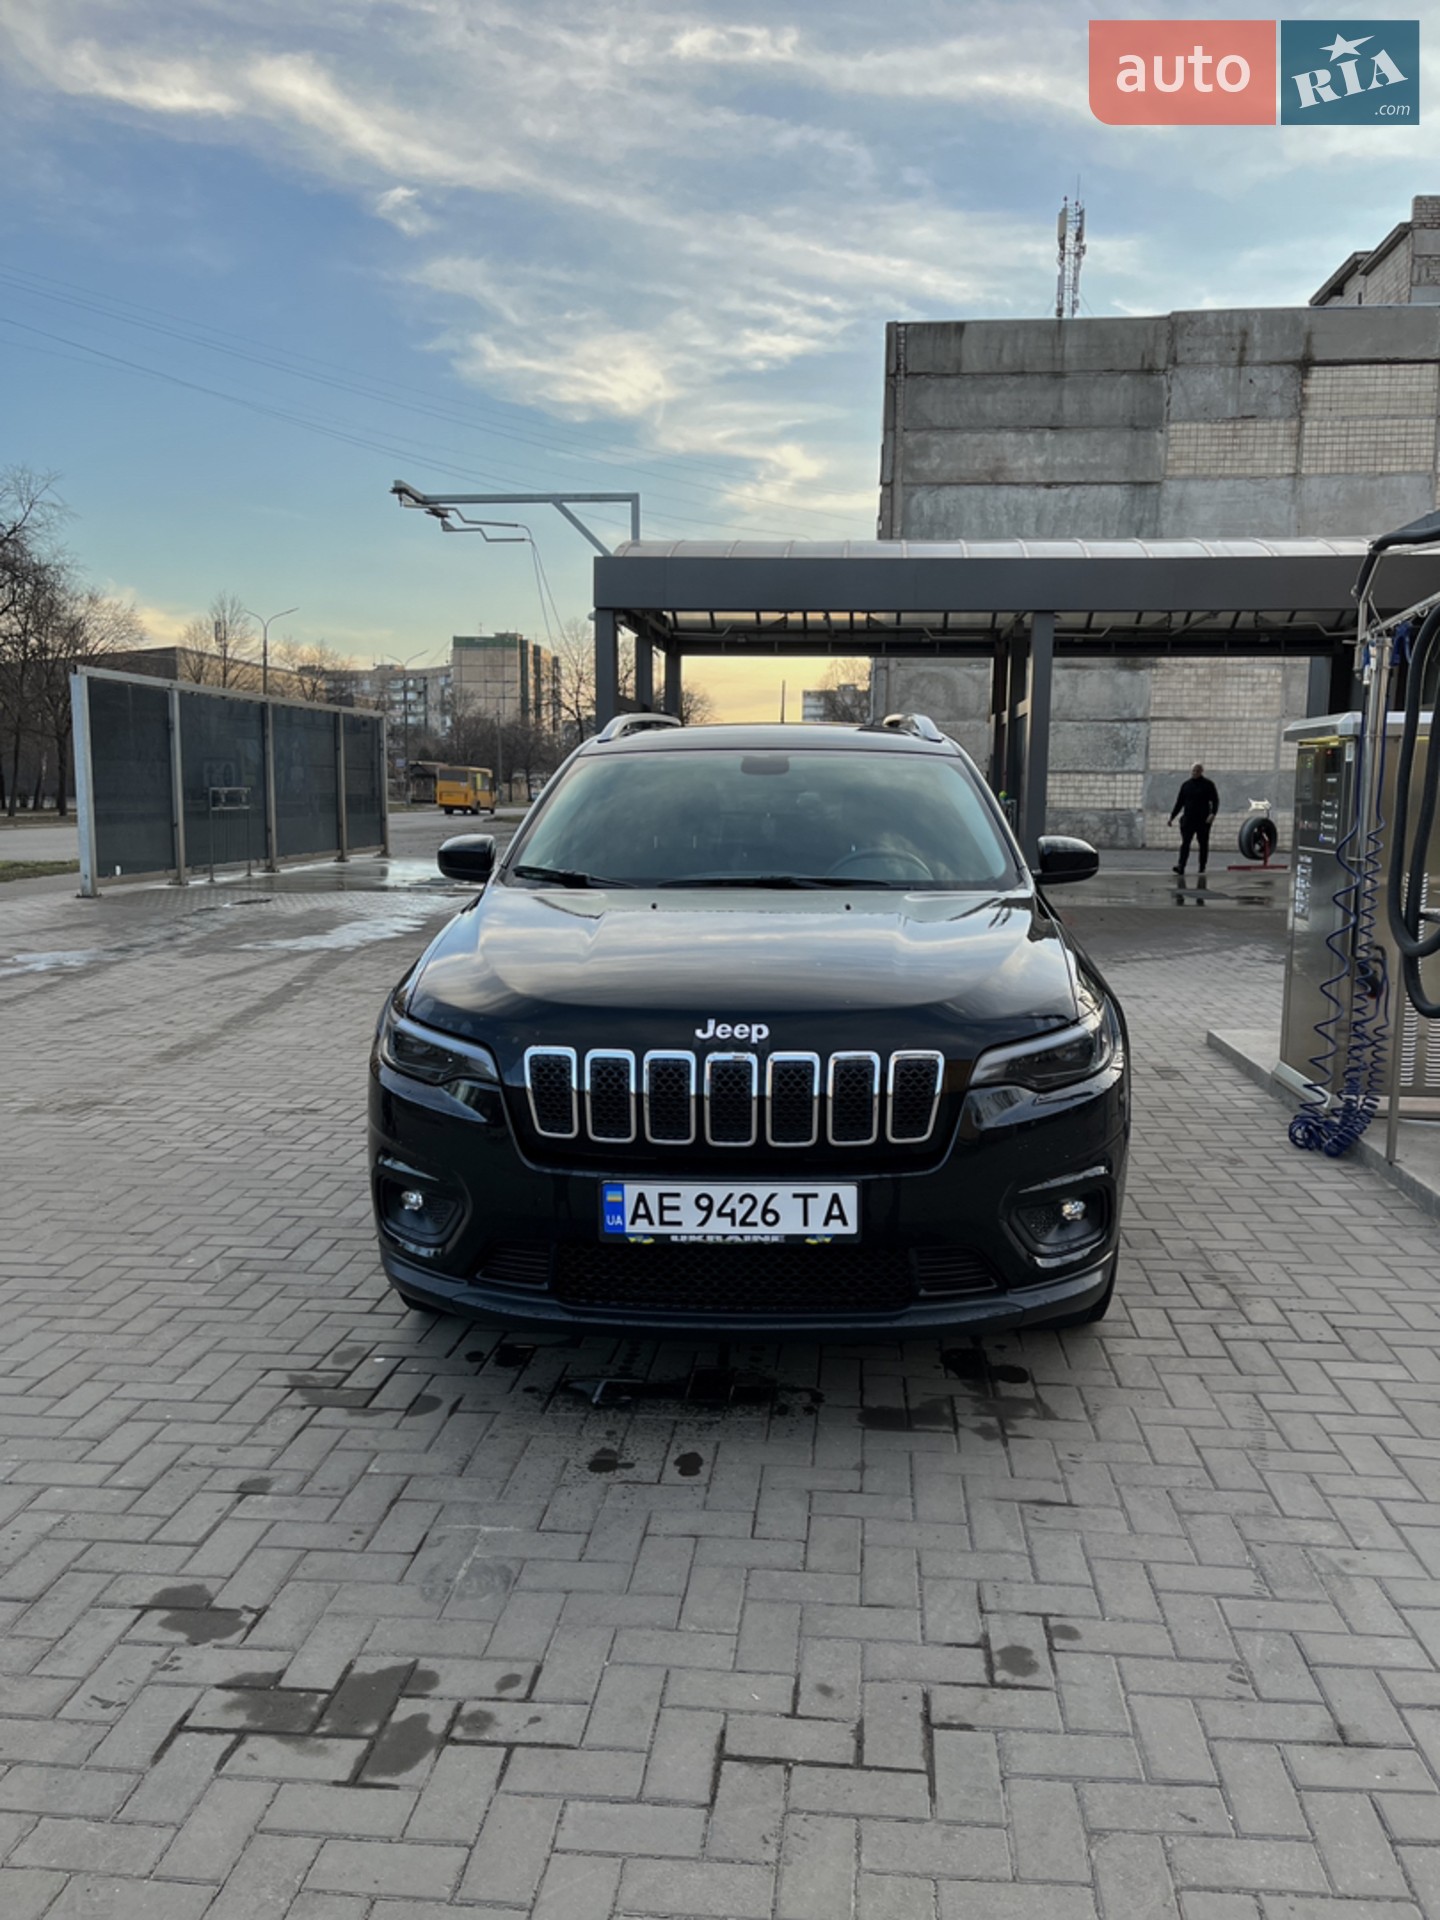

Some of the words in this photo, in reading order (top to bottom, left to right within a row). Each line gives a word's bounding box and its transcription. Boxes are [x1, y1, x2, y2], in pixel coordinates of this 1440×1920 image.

[695, 1018, 770, 1044] Jeep
[606, 1214, 623, 1226] UA
[629, 1192, 683, 1227] AE
[694, 1192, 781, 1228] 9426
[792, 1193, 849, 1227] TA
